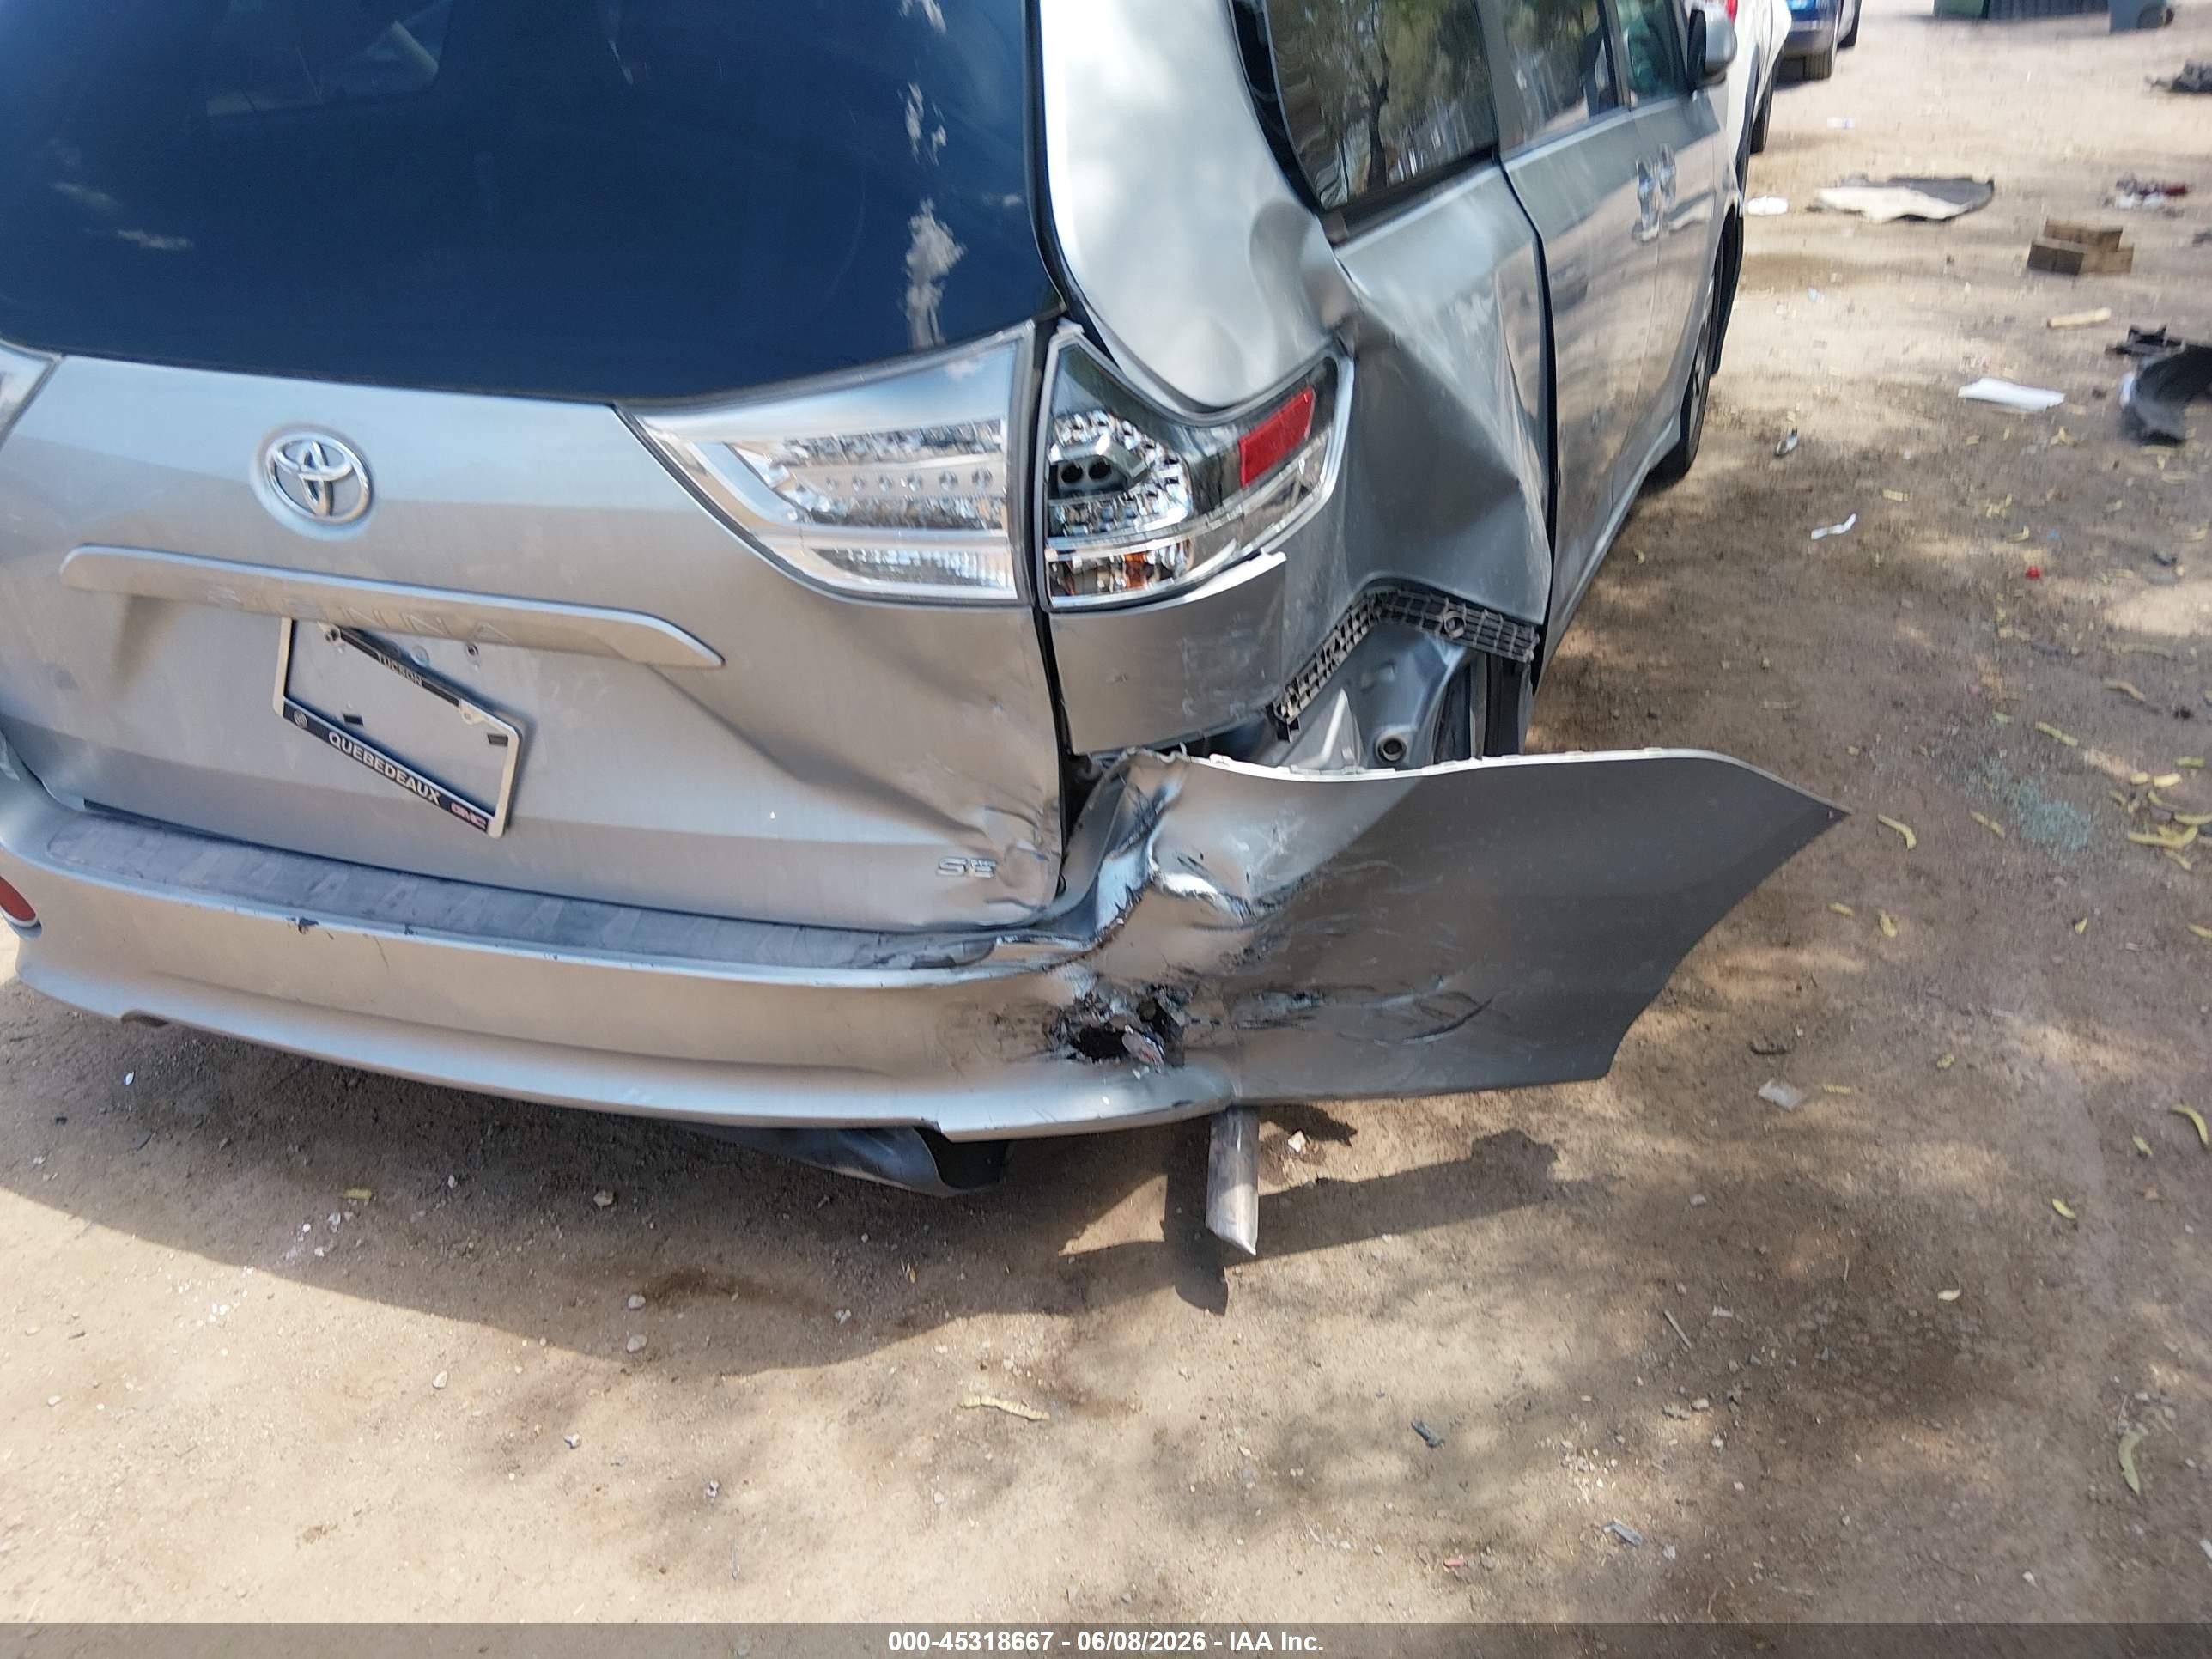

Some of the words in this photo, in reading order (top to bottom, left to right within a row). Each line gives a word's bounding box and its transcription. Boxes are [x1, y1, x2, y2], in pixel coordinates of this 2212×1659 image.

[328, 731, 441, 806] QUEBEDEAUX
[451, 802, 487, 830] GMC
[937, 857, 997, 878] SE
